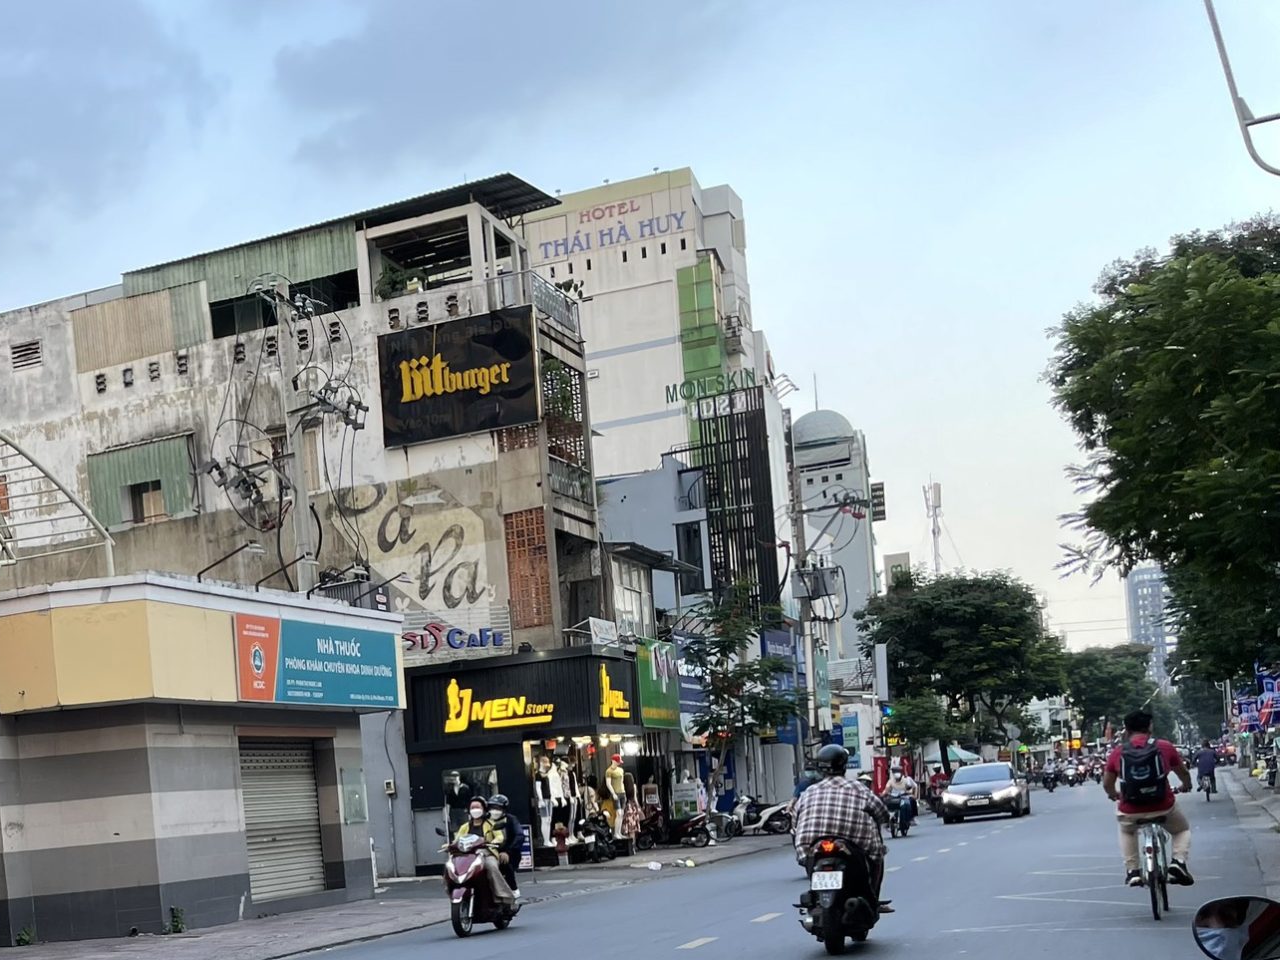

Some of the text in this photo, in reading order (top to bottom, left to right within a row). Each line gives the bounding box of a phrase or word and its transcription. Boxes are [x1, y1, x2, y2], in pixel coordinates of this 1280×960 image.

[579, 200, 640, 224] HOTEL
[539, 211, 686, 259] THÁI HÀ HUY
[716, 367, 756, 393] SKIN
[317, 636, 361, 657] NHÀ THUỐC
[285, 657, 306, 671] PHÒNG
[526, 702, 554, 716] Store
